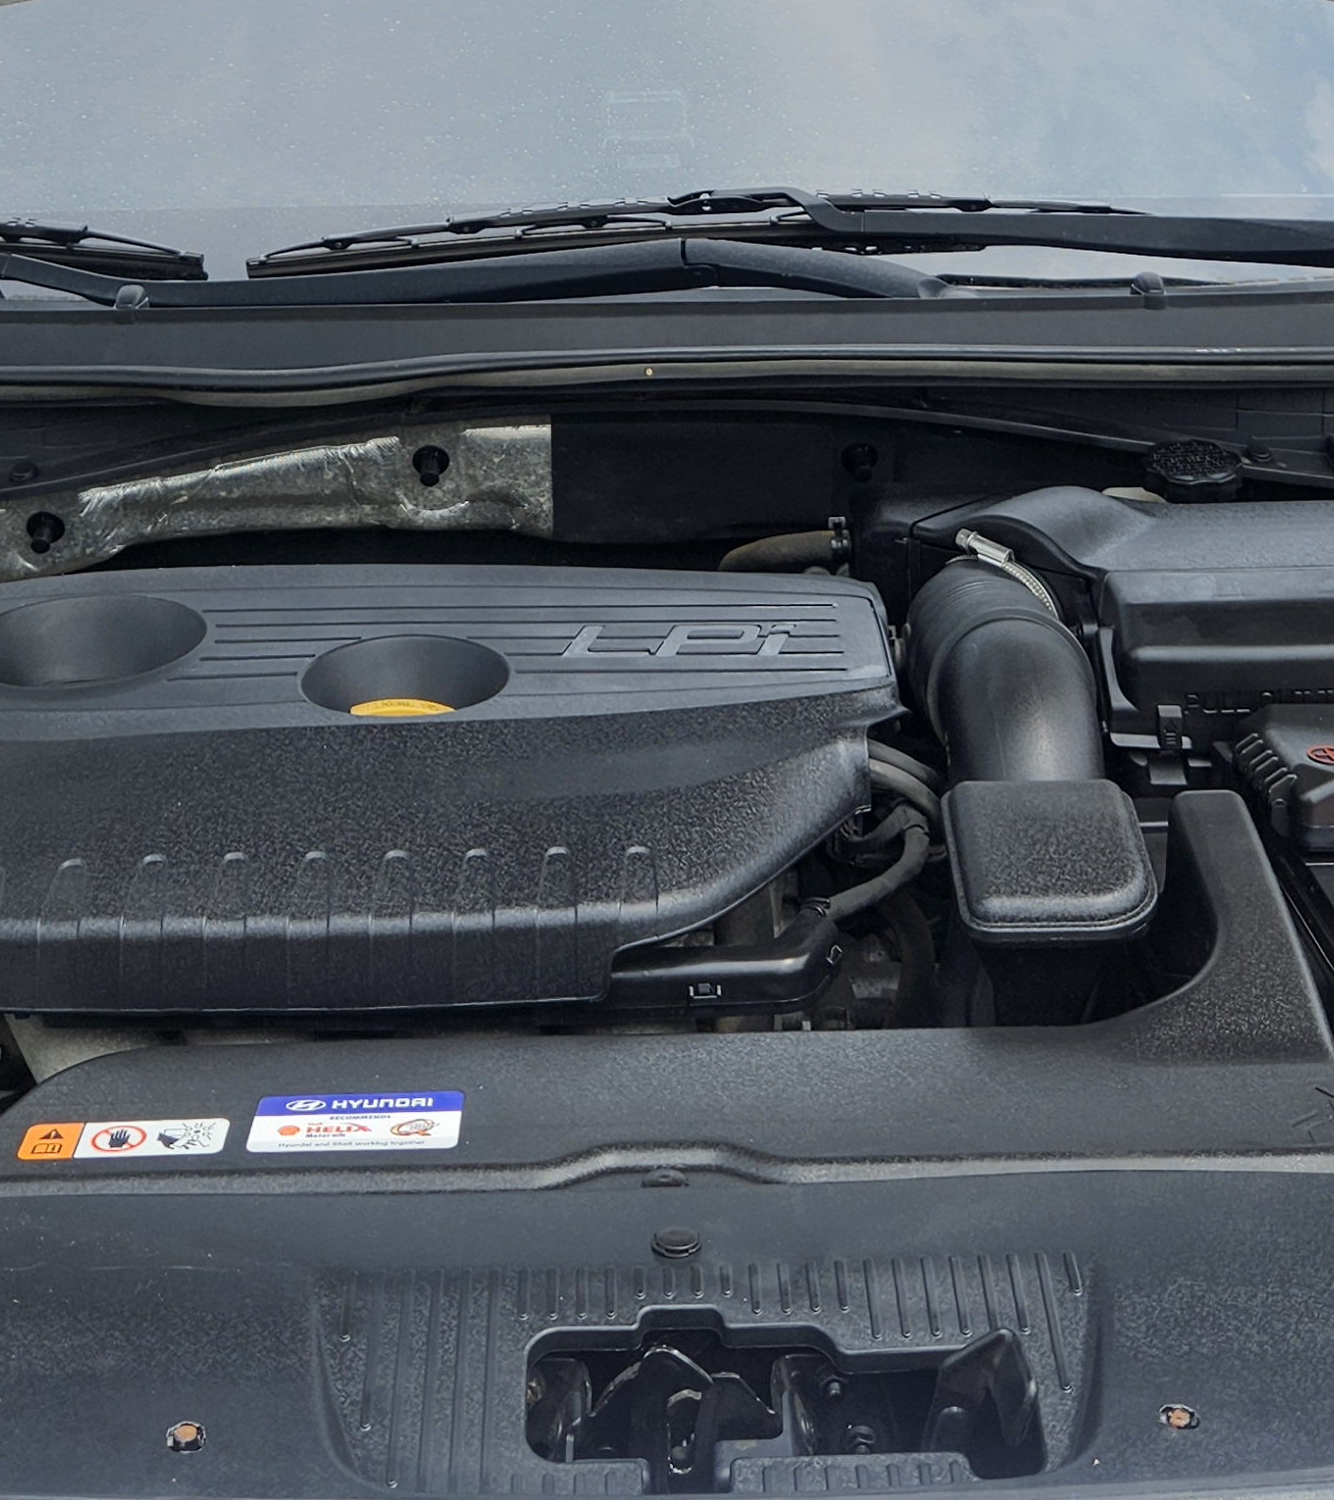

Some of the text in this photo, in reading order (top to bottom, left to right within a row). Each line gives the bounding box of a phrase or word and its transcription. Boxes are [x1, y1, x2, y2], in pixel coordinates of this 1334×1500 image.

[561, 624, 797, 658] LPi
[1183, 690, 1251, 714] PULL
[331, 1097, 434, 1110] HYUNDAI
[305, 1124, 372, 1134] HELIX
